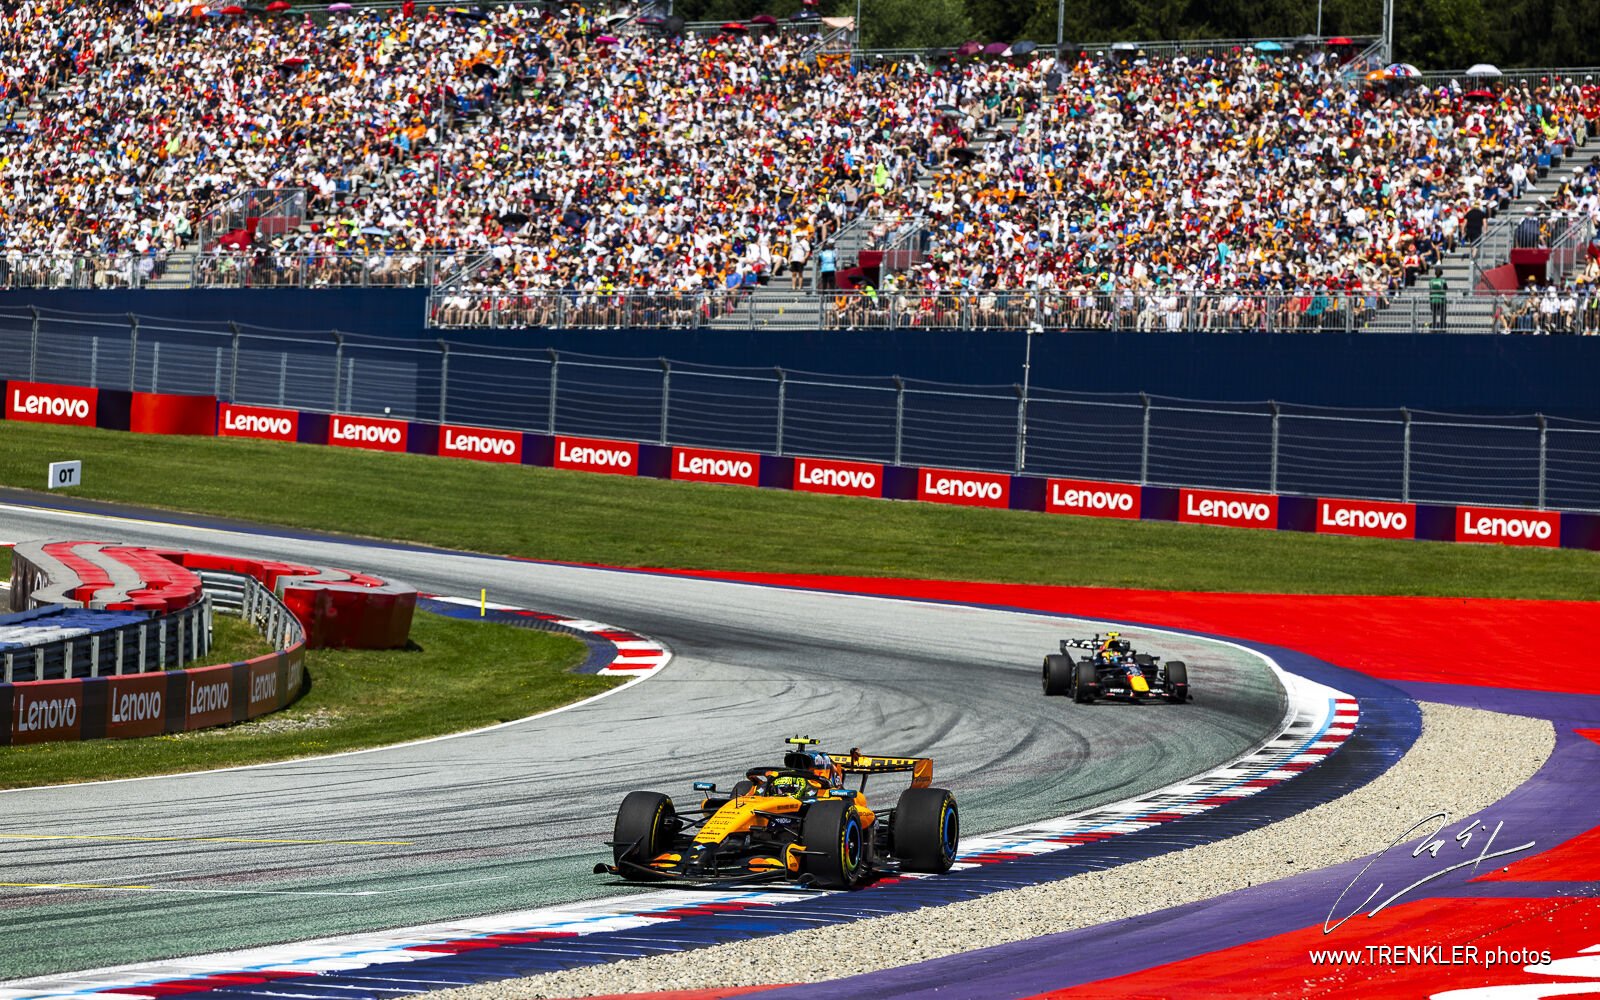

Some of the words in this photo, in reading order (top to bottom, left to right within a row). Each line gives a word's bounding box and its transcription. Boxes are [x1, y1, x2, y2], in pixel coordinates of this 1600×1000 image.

[14, 389, 89, 418] Lenovo
[225, 409, 292, 434] Lenovo
[333, 419, 401, 444] Lenovo
[445, 429, 516, 455] Lenovo
[560, 441, 632, 467] Lenovo
[59, 468, 75, 483] OT
[678, 453, 752, 477] Lenovo
[800, 463, 876, 488] Lenovo
[925, 473, 1002, 499] Lenovo
[1053, 484, 1133, 510] Lenovo
[1187, 494, 1270, 521] Lenovo
[1322, 503, 1407, 530] Lenovo
[1463, 512, 1552, 539] Lenovo
[190, 680, 229, 714] Lenovo
[251, 671, 277, 703] Lenovo
[18, 694, 77, 732] Lenovo
[112, 687, 161, 722] Lenovo
